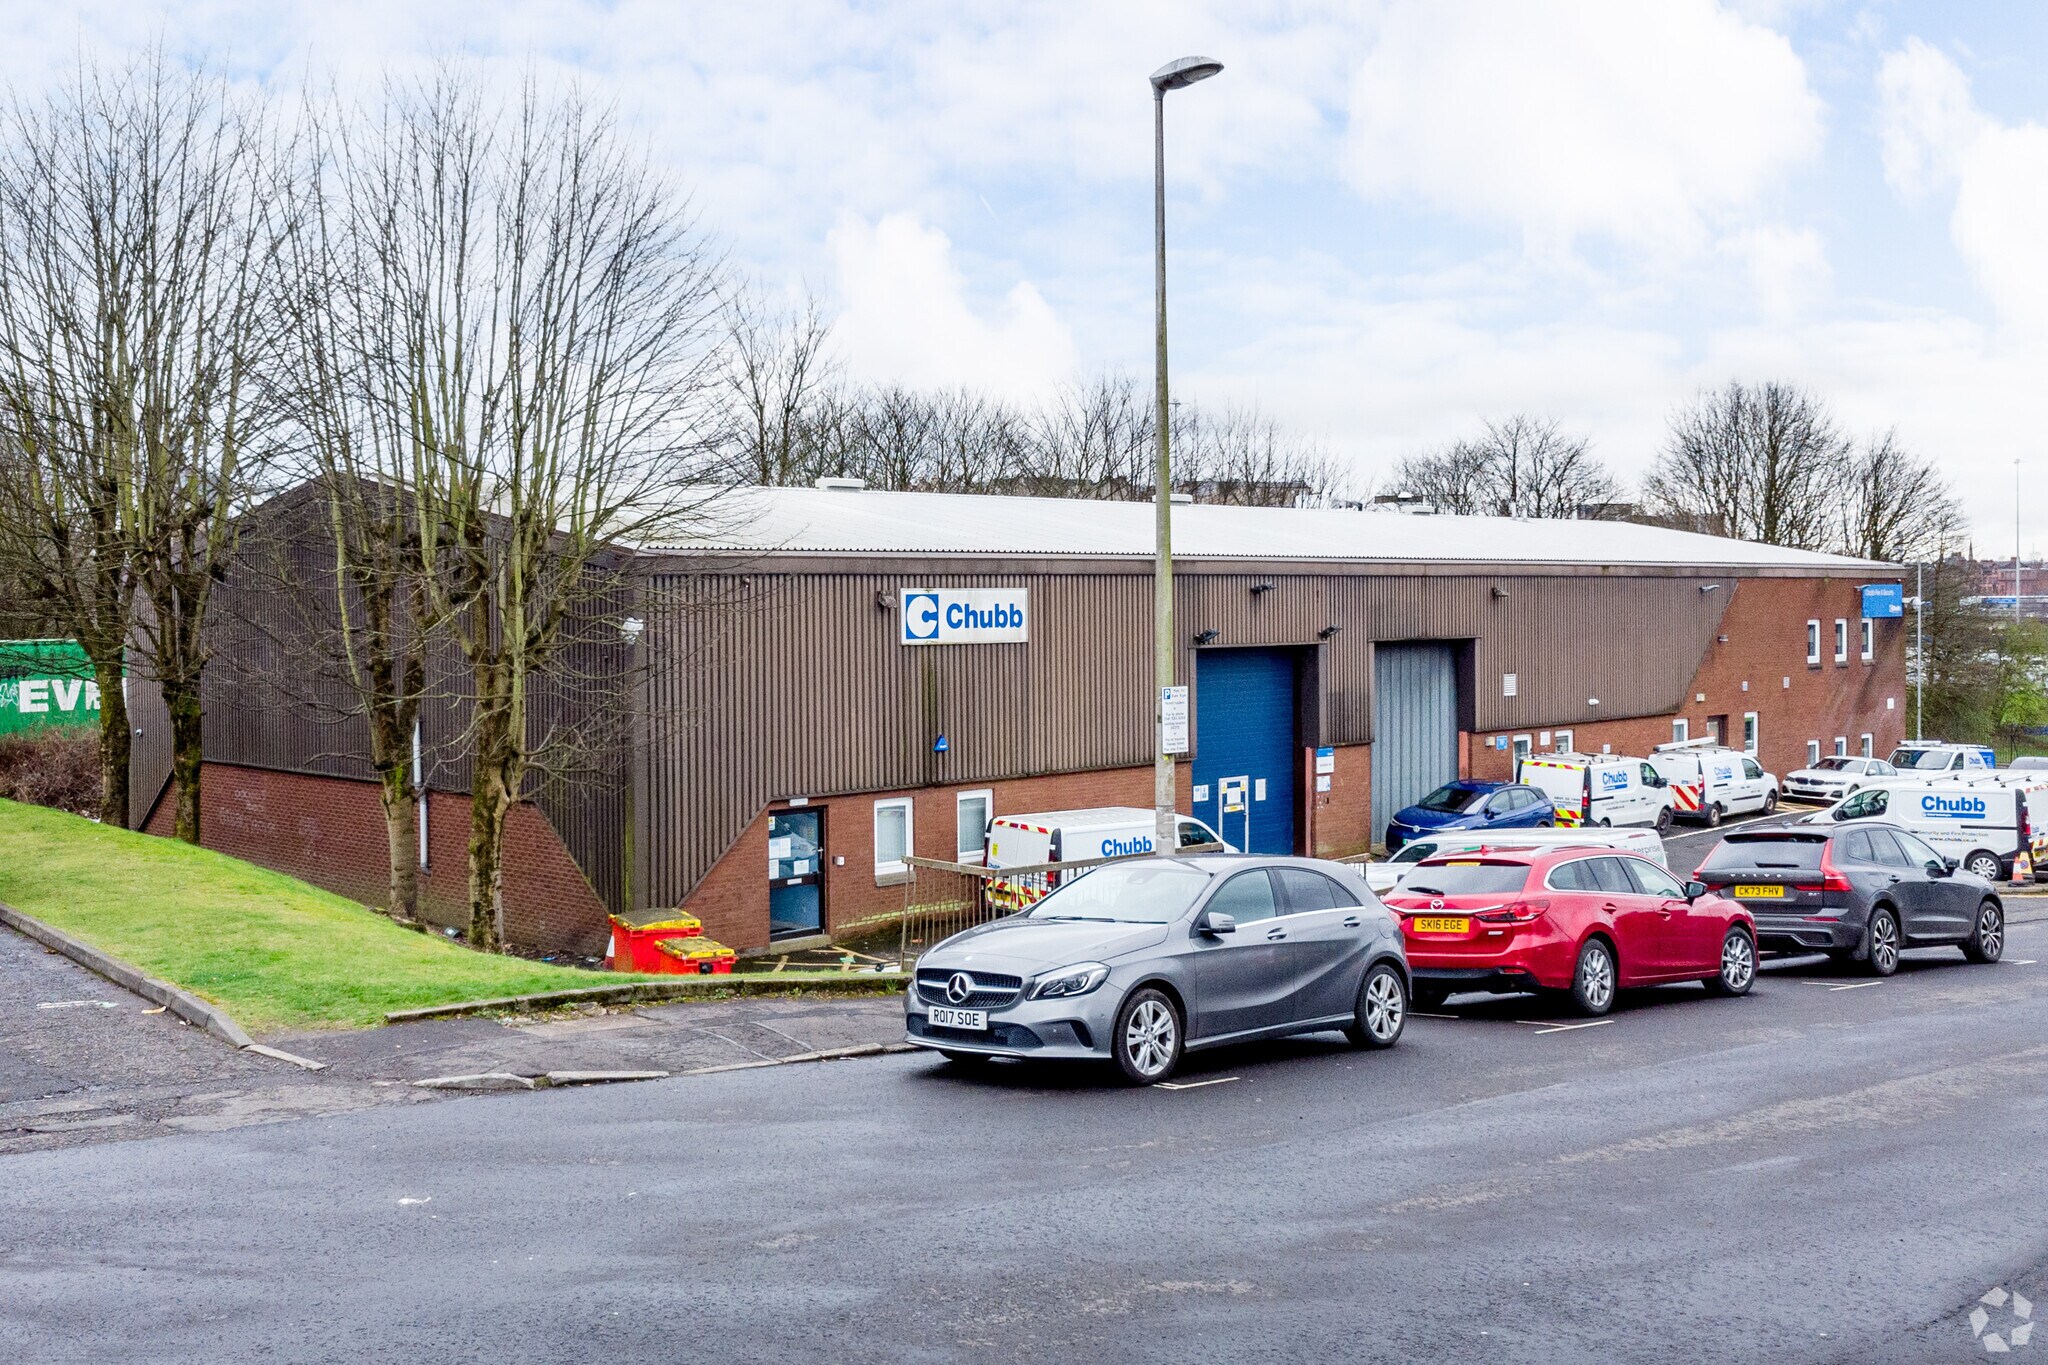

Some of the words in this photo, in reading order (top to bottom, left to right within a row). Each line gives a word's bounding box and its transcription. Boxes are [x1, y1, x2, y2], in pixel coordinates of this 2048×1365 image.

[946, 603, 1023, 630] Chubb
[1602, 770, 1628, 785] Chubb
[1921, 795, 1986, 812] Chubb
[1101, 836, 1152, 857] Chubb
[1738, 888, 1761, 896] CK73
[1762, 888, 1780, 896] FHV
[1421, 919, 1442, 930] SK16
[1443, 919, 1463, 930] EGE
[933, 1009, 955, 1024] RO17
[957, 1012, 980, 1027] SOE
